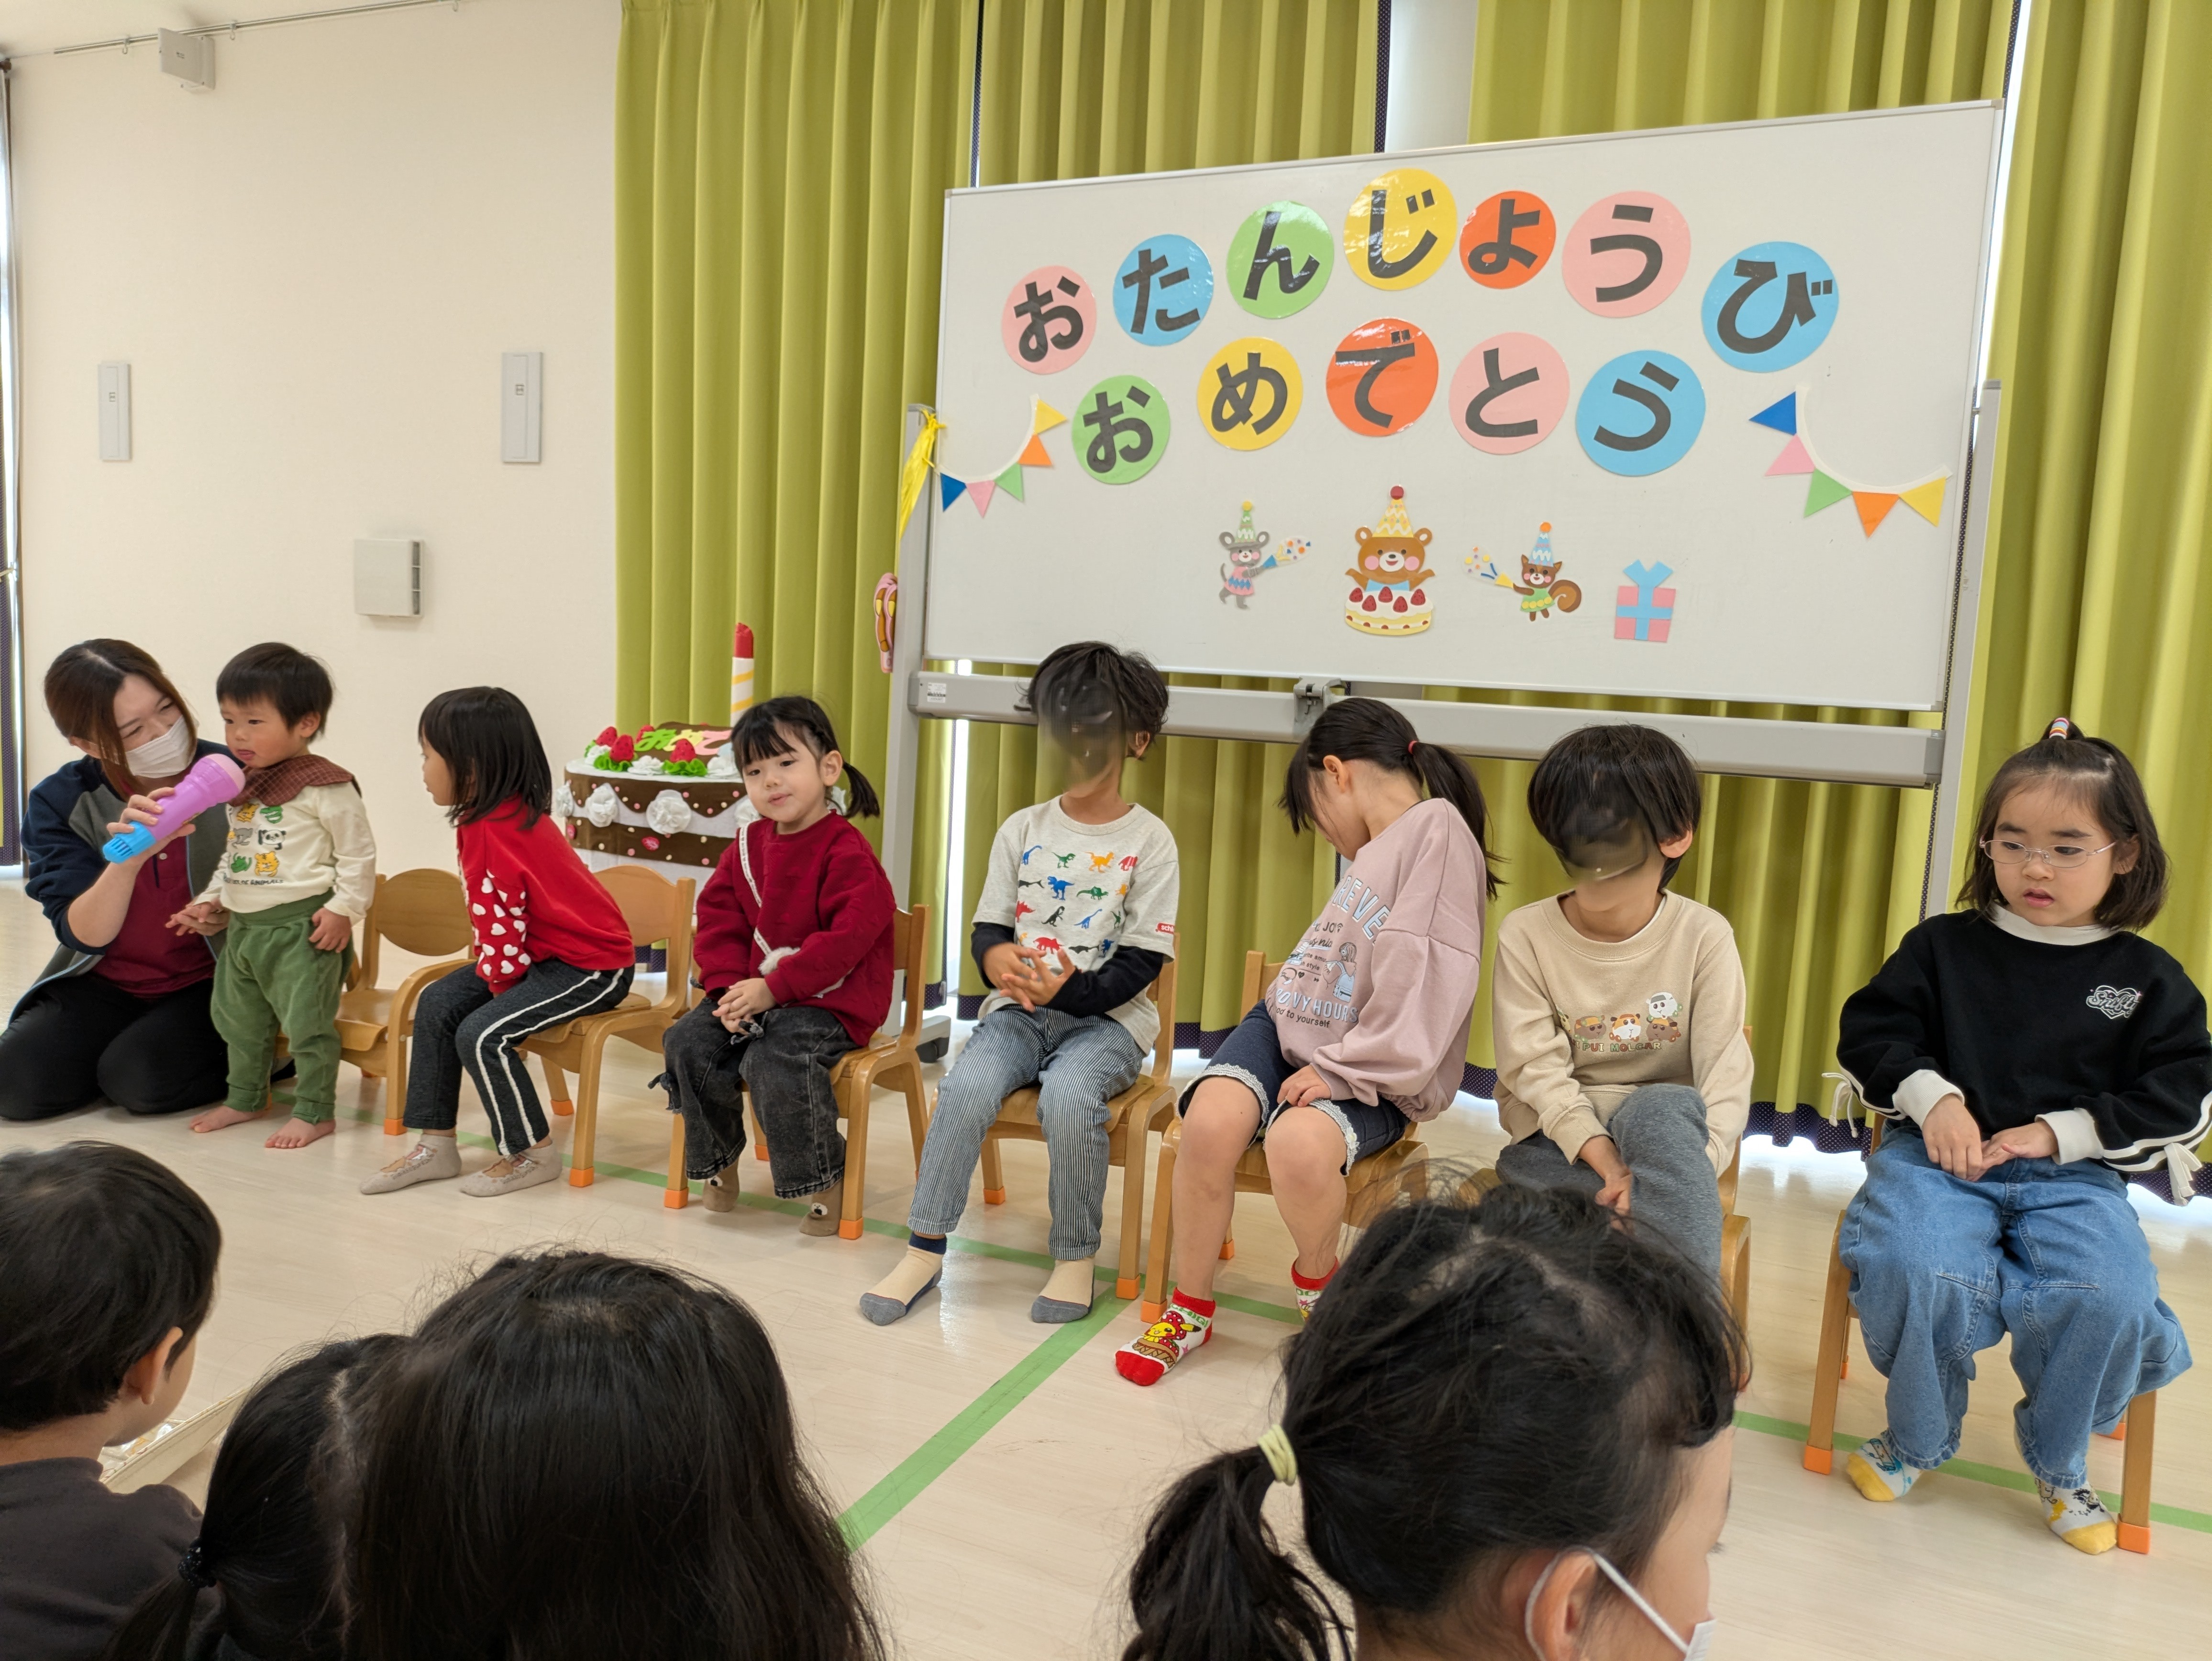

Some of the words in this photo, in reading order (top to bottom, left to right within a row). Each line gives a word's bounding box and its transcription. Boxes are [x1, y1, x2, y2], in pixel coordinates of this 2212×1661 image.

[1014, 188, 1833, 362] おたんじょうび
[1083, 329, 1680, 473] おめでとう
[1332, 875, 1391, 941] REVE
[1306, 963, 1320, 971] style
[1286, 1009, 1295, 1019] to
[1295, 1014, 1331, 1029] yourself
[1312, 999, 1359, 1024] HOURS
[1582, 1042, 1604, 1052] PUI
[1610, 1041, 1662, 1052] MOLCAR
